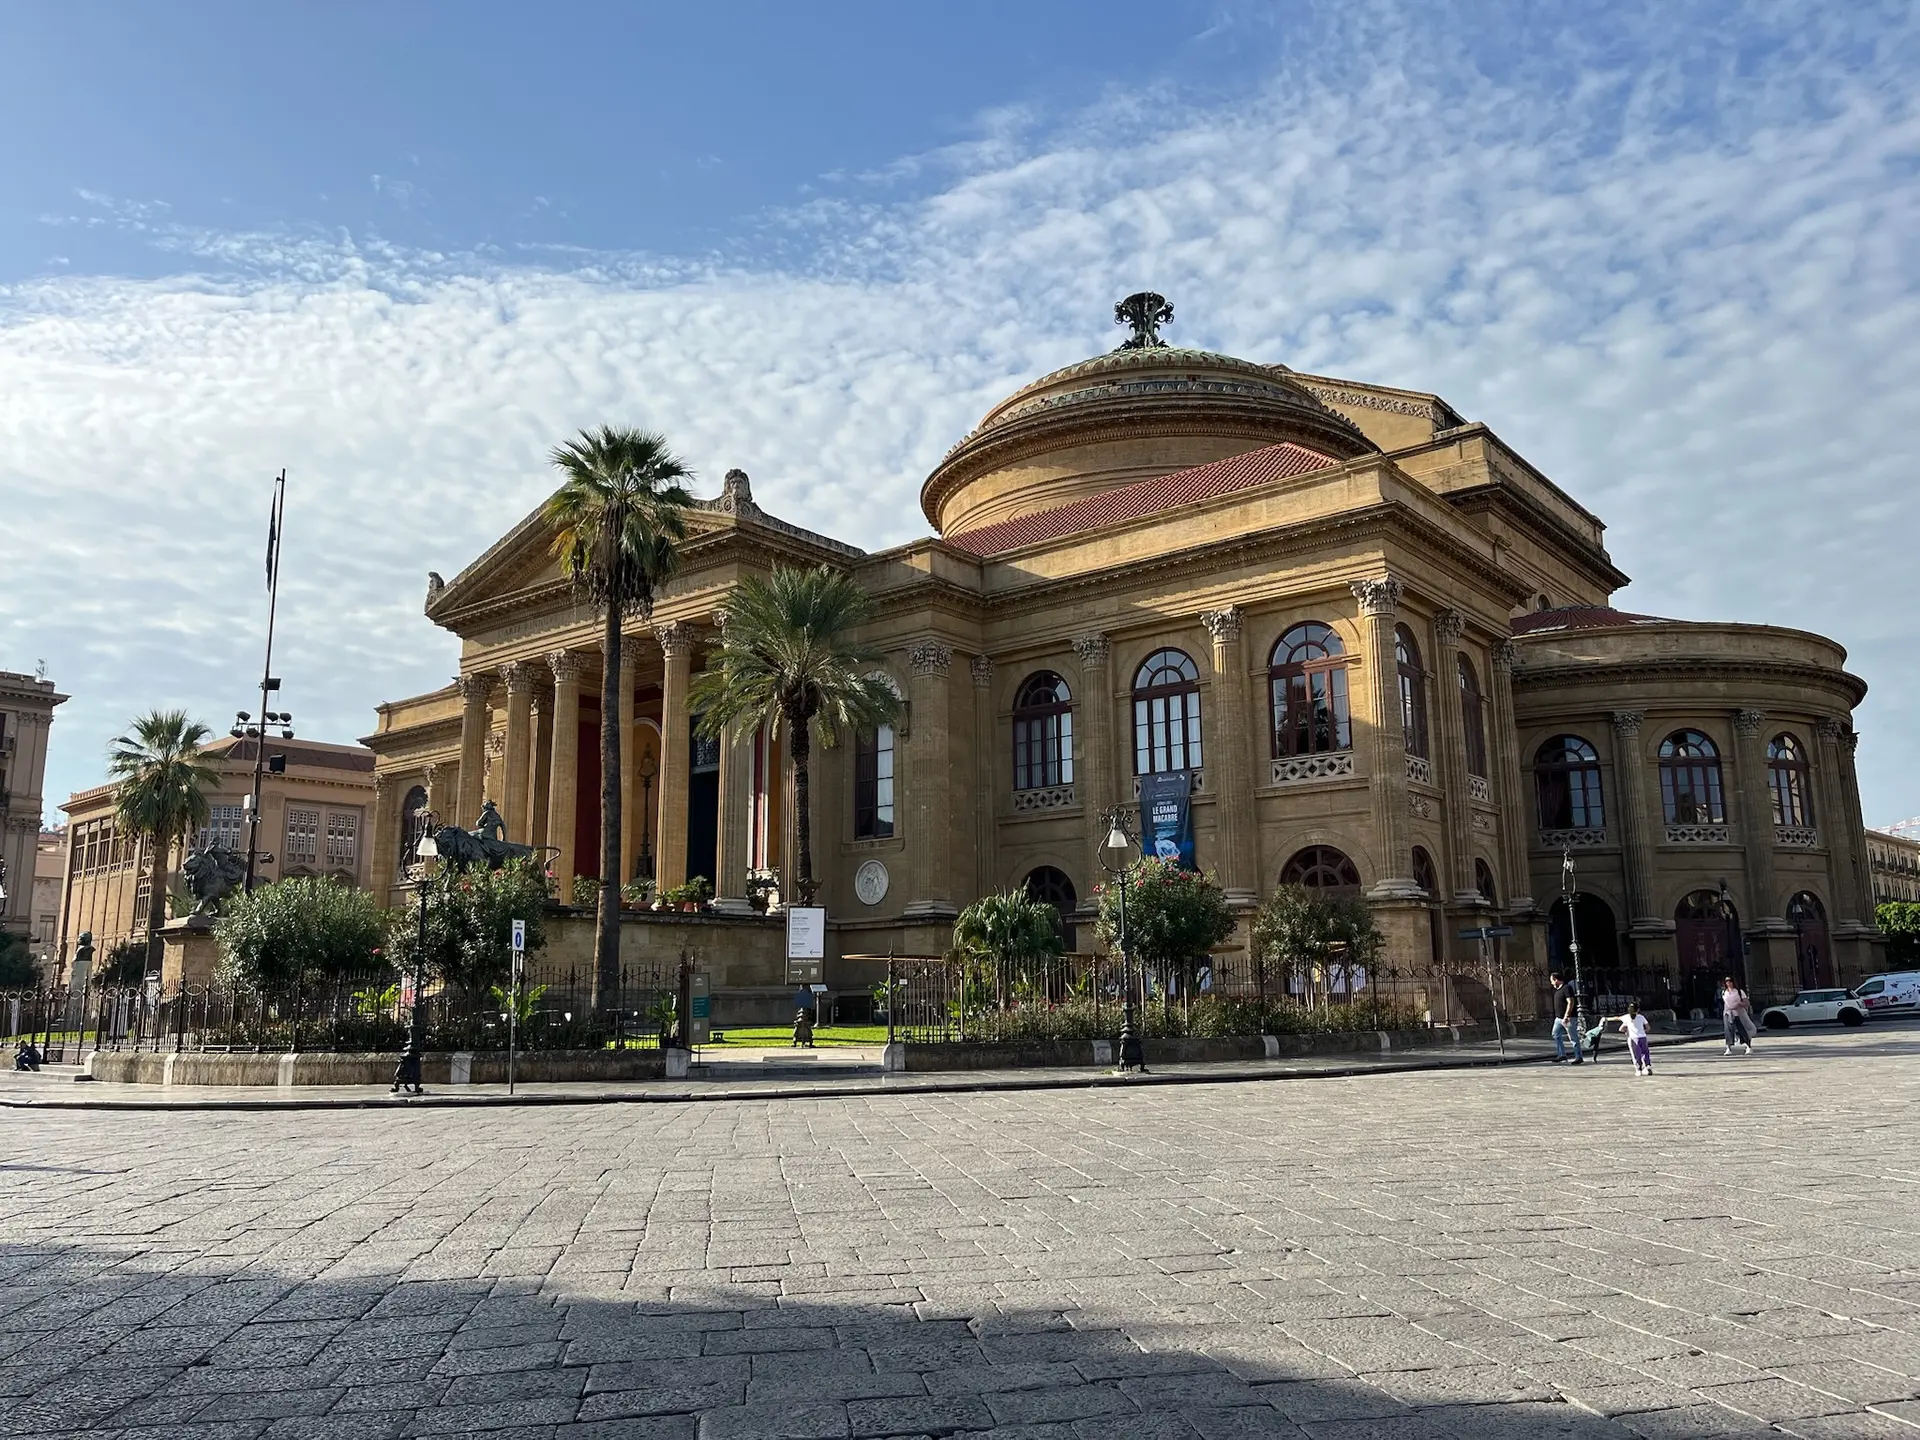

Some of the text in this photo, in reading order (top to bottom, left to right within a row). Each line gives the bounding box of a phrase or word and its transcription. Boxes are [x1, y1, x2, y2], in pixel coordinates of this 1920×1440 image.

[1152, 805, 1178, 815] LE GRAND
[1152, 814, 1178, 823] MACABRE
